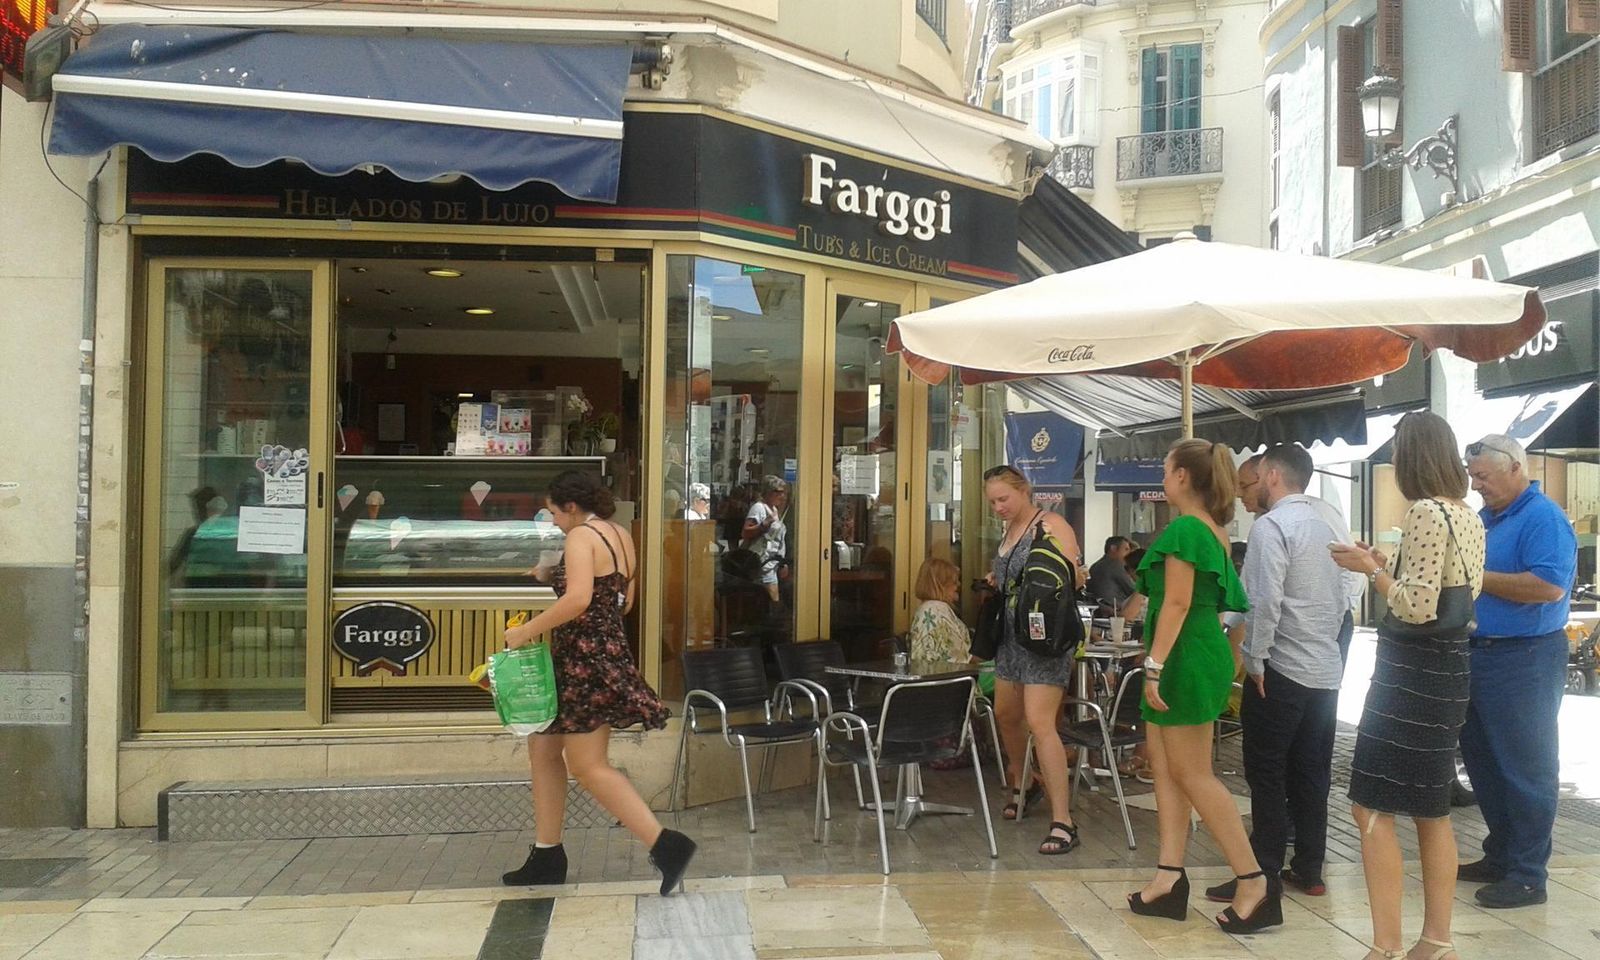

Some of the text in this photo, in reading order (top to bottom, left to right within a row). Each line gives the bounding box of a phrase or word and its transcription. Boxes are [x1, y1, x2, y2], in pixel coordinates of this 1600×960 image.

[283, 189, 550, 223] HELADOS DE LUJO
[805, 153, 952, 241] Farggi
[866, 238, 893, 265] ICE
[895, 245, 949, 276] CREAM
[344, 624, 422, 647] Farggi
